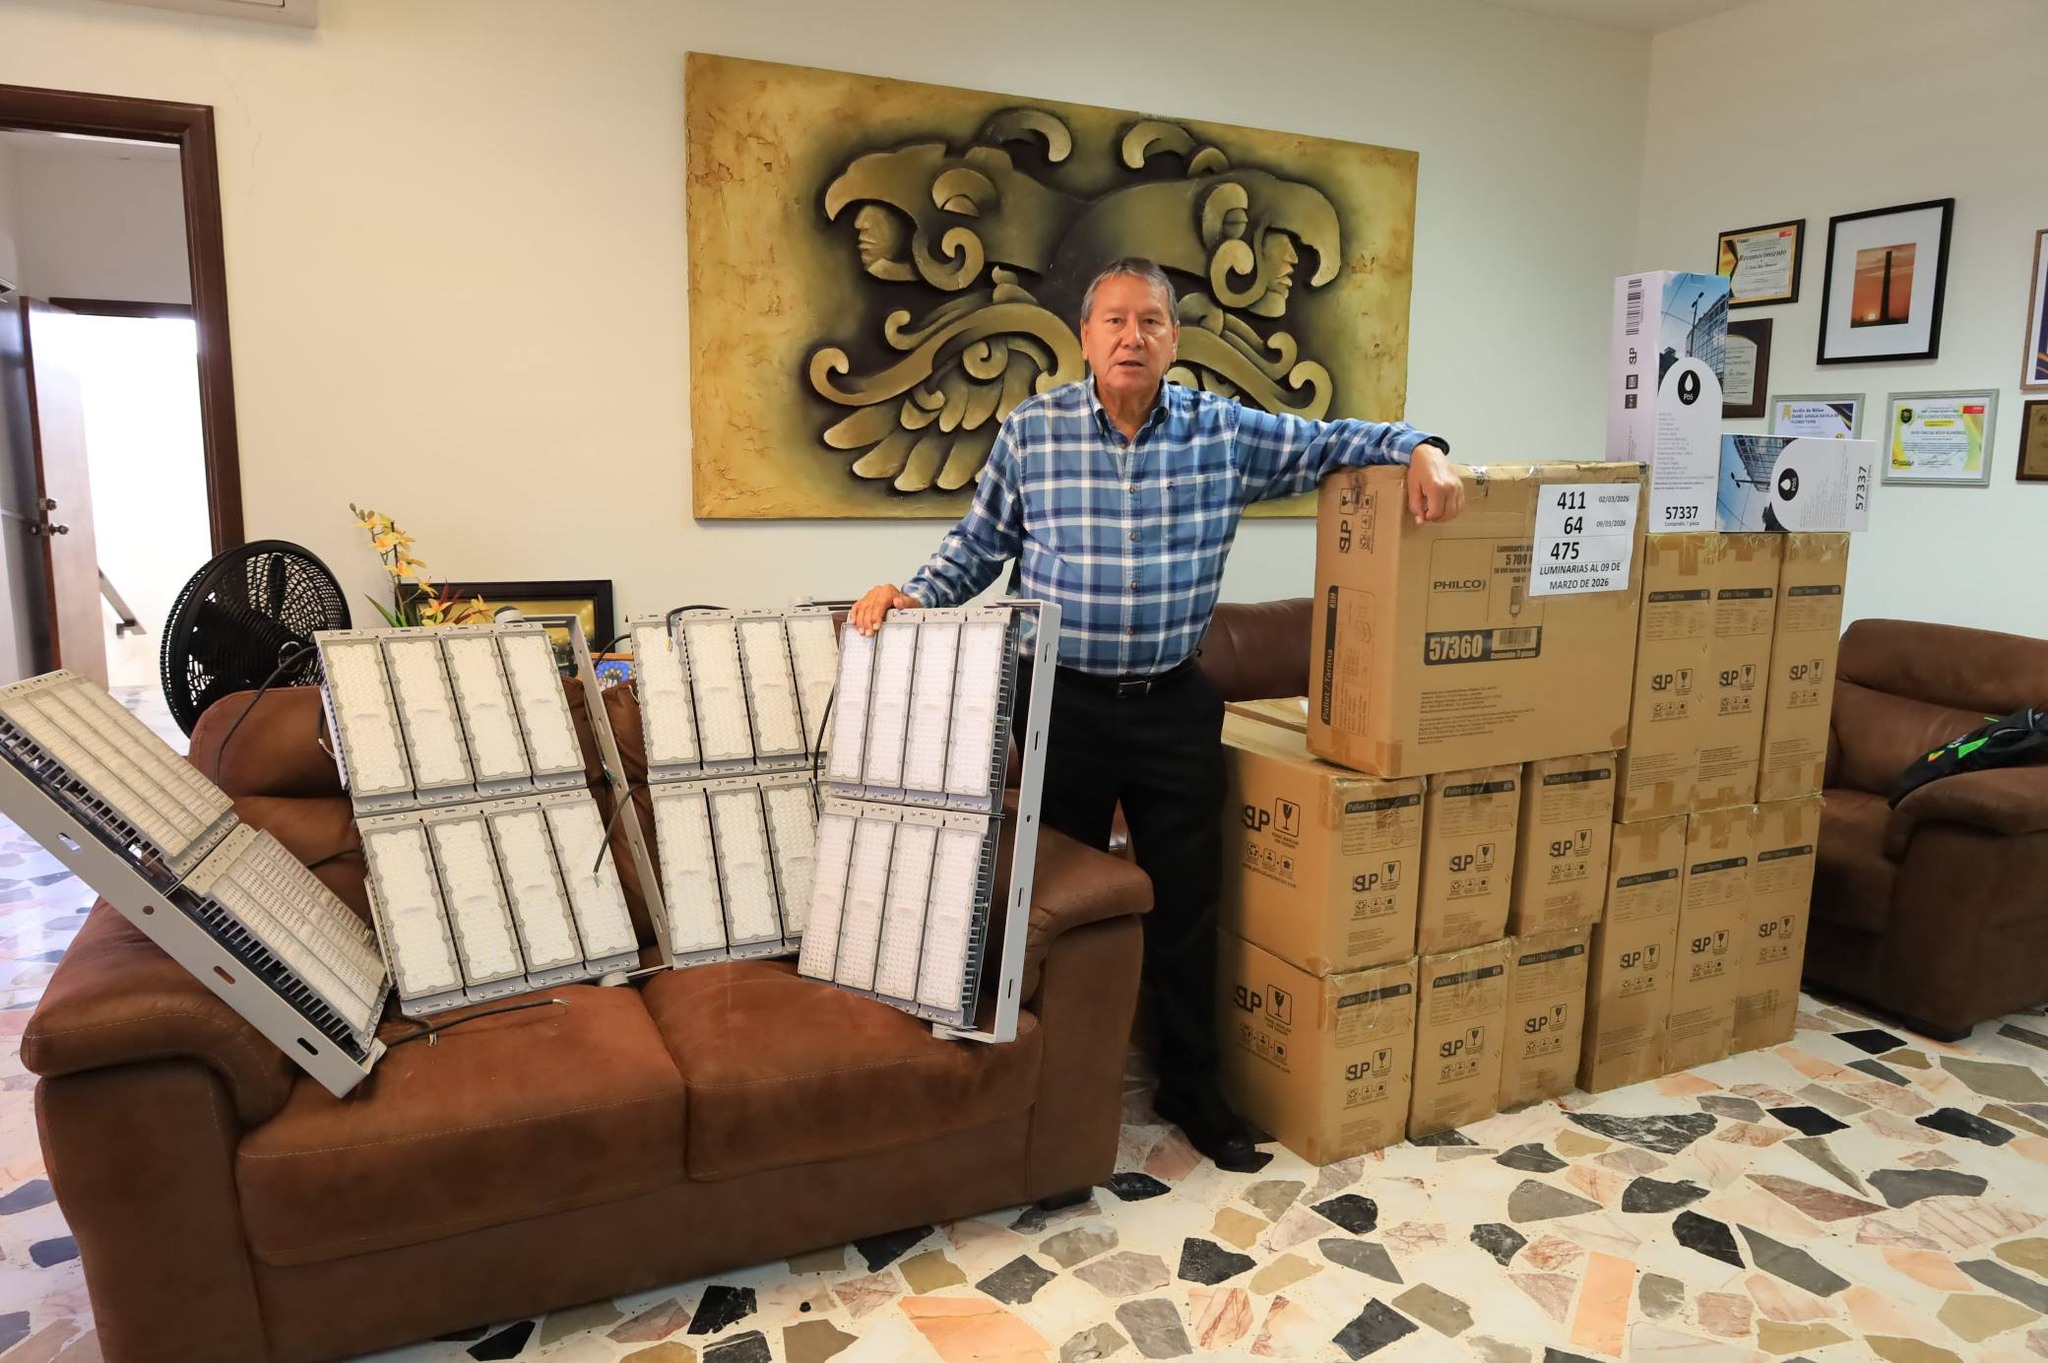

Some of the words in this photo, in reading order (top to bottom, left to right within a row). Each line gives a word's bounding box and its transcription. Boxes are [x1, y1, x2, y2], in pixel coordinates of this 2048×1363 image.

[1855, 466, 1867, 510] 57337
[1557, 491, 1586, 510] 411
[1598, 496, 1630, 504] 02/03/2026
[1665, 506, 1698, 520] 57337
[1564, 516, 1583, 535] 64
[1550, 542, 1580, 560] 475
[1540, 564, 1588, 576] LUMINARIAS
[1590, 564, 1599, 573] AL
[1600, 562, 1610, 572] 09
[1611, 562, 1621, 571] DE
[1549, 580, 1578, 590] MARZO
[1580, 579, 1590, 588] DE
[1591, 578, 1610, 588] 2026
[1429, 634, 1482, 660] 57360
[1324, 649, 1333, 682] Tarima
[1322, 690, 1331, 720] Pallet
